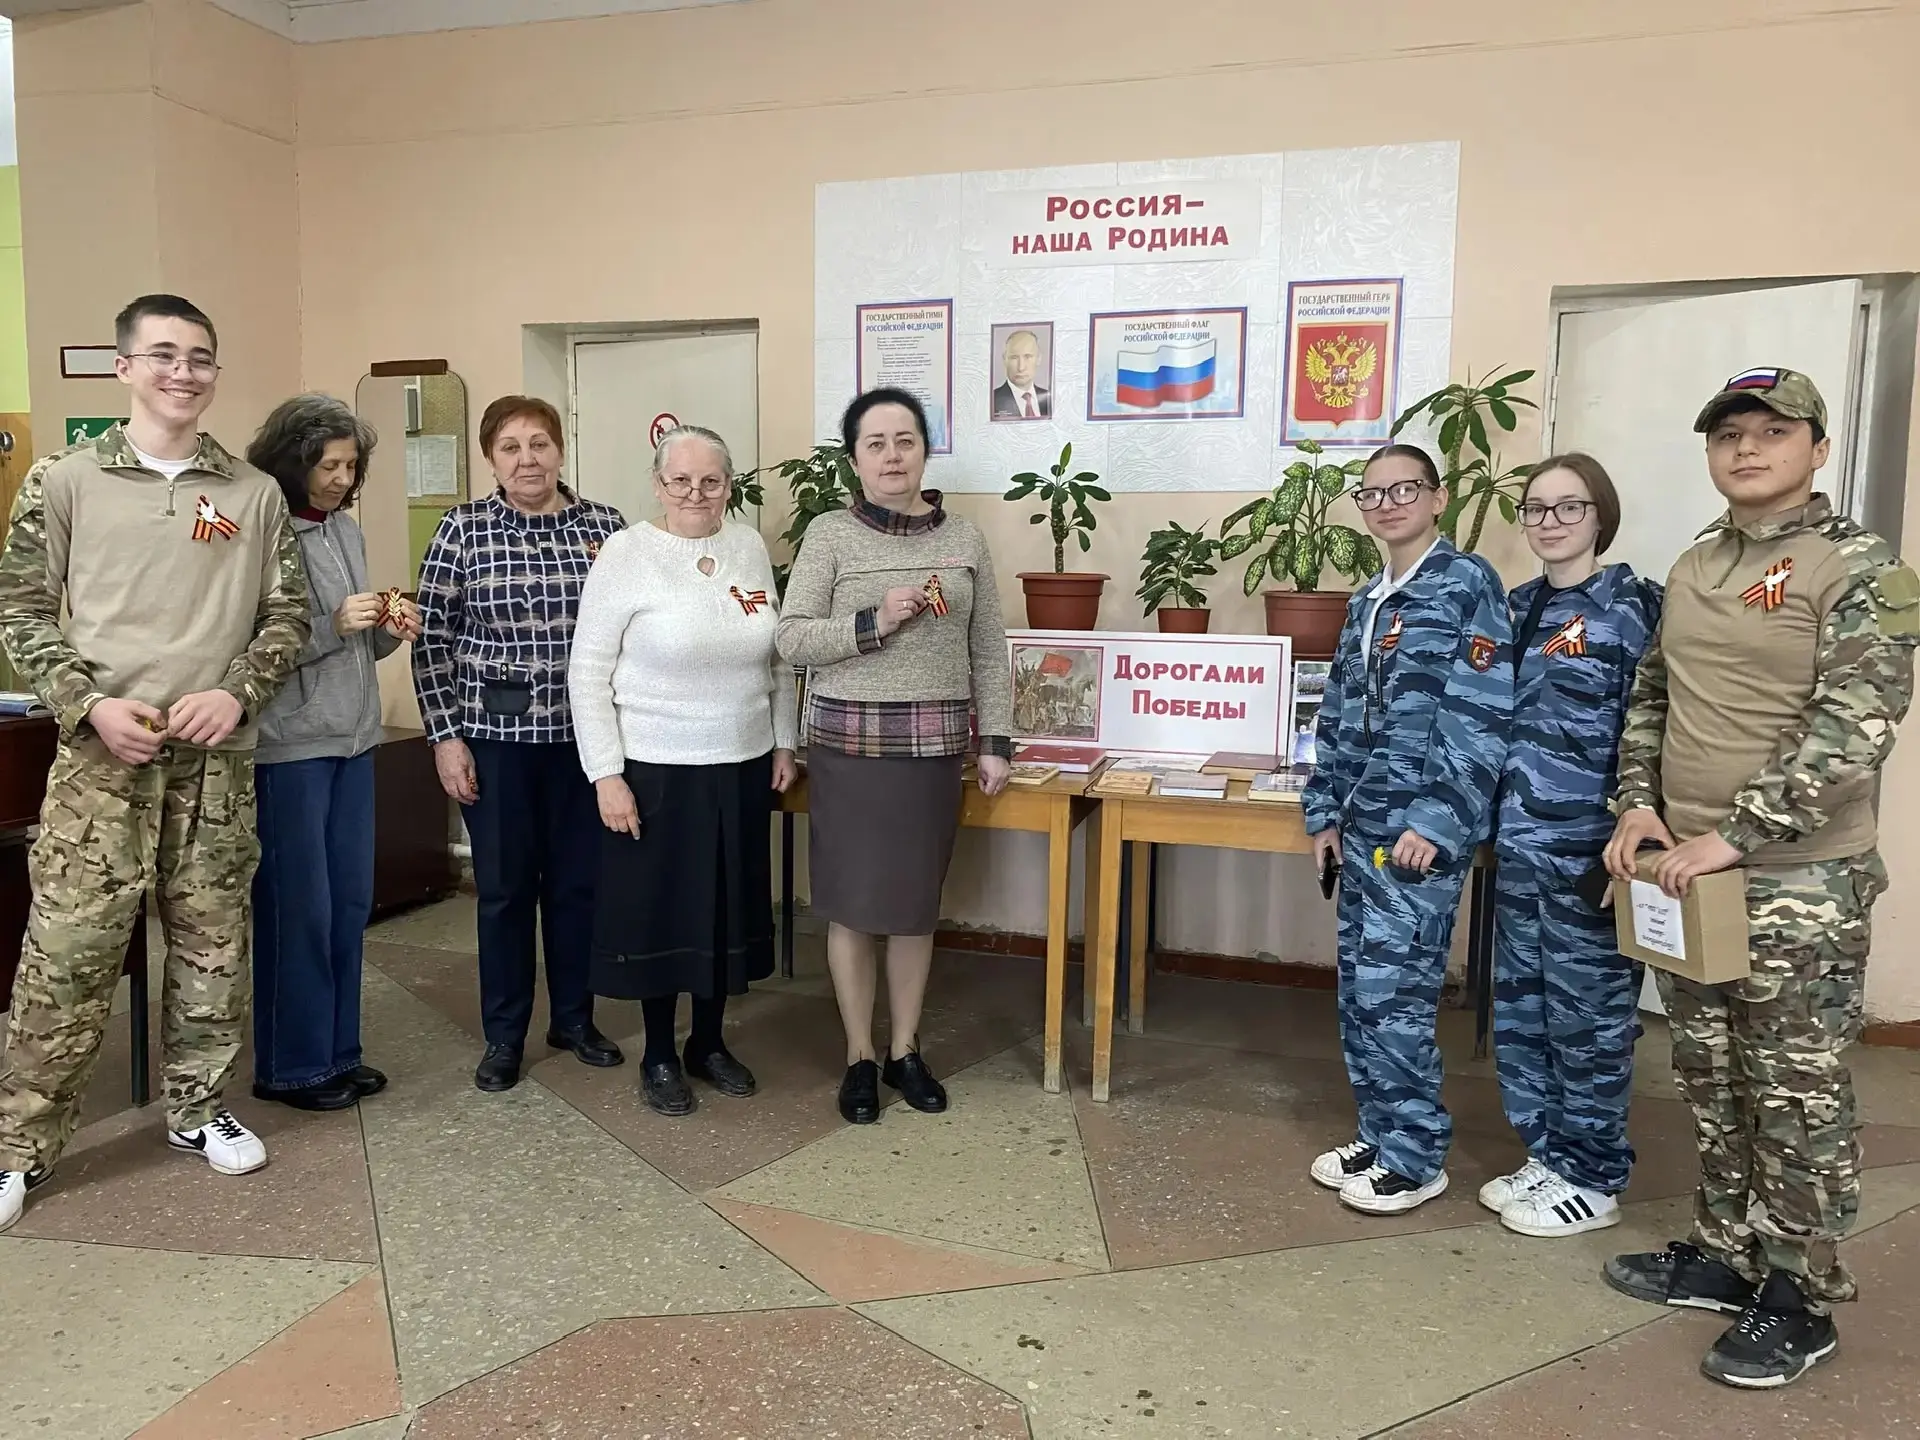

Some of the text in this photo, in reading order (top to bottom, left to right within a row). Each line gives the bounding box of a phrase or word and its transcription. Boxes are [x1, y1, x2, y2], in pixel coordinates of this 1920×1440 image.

[1299, 292, 1390, 304] ГОСУДАРСТВЕННЫЙ ГЕРБ
[866, 311, 943, 321] ГОСУДАРСТВЕННЫЙ ГИМН
[1298, 305, 1390, 316] РОССИЙСКОЙ ФЕДЕРАЦИИ
[866, 322, 943, 332] РОССИЙСКОЙ ФЕДЕРАЦИИ
[1125, 320, 1209, 331] ГОСУДАРСТВЕННЫЙ ФЛАГ
[1124, 331, 1210, 343] РОССИЙСКОЙ ФЕДЕРАЦИИ
